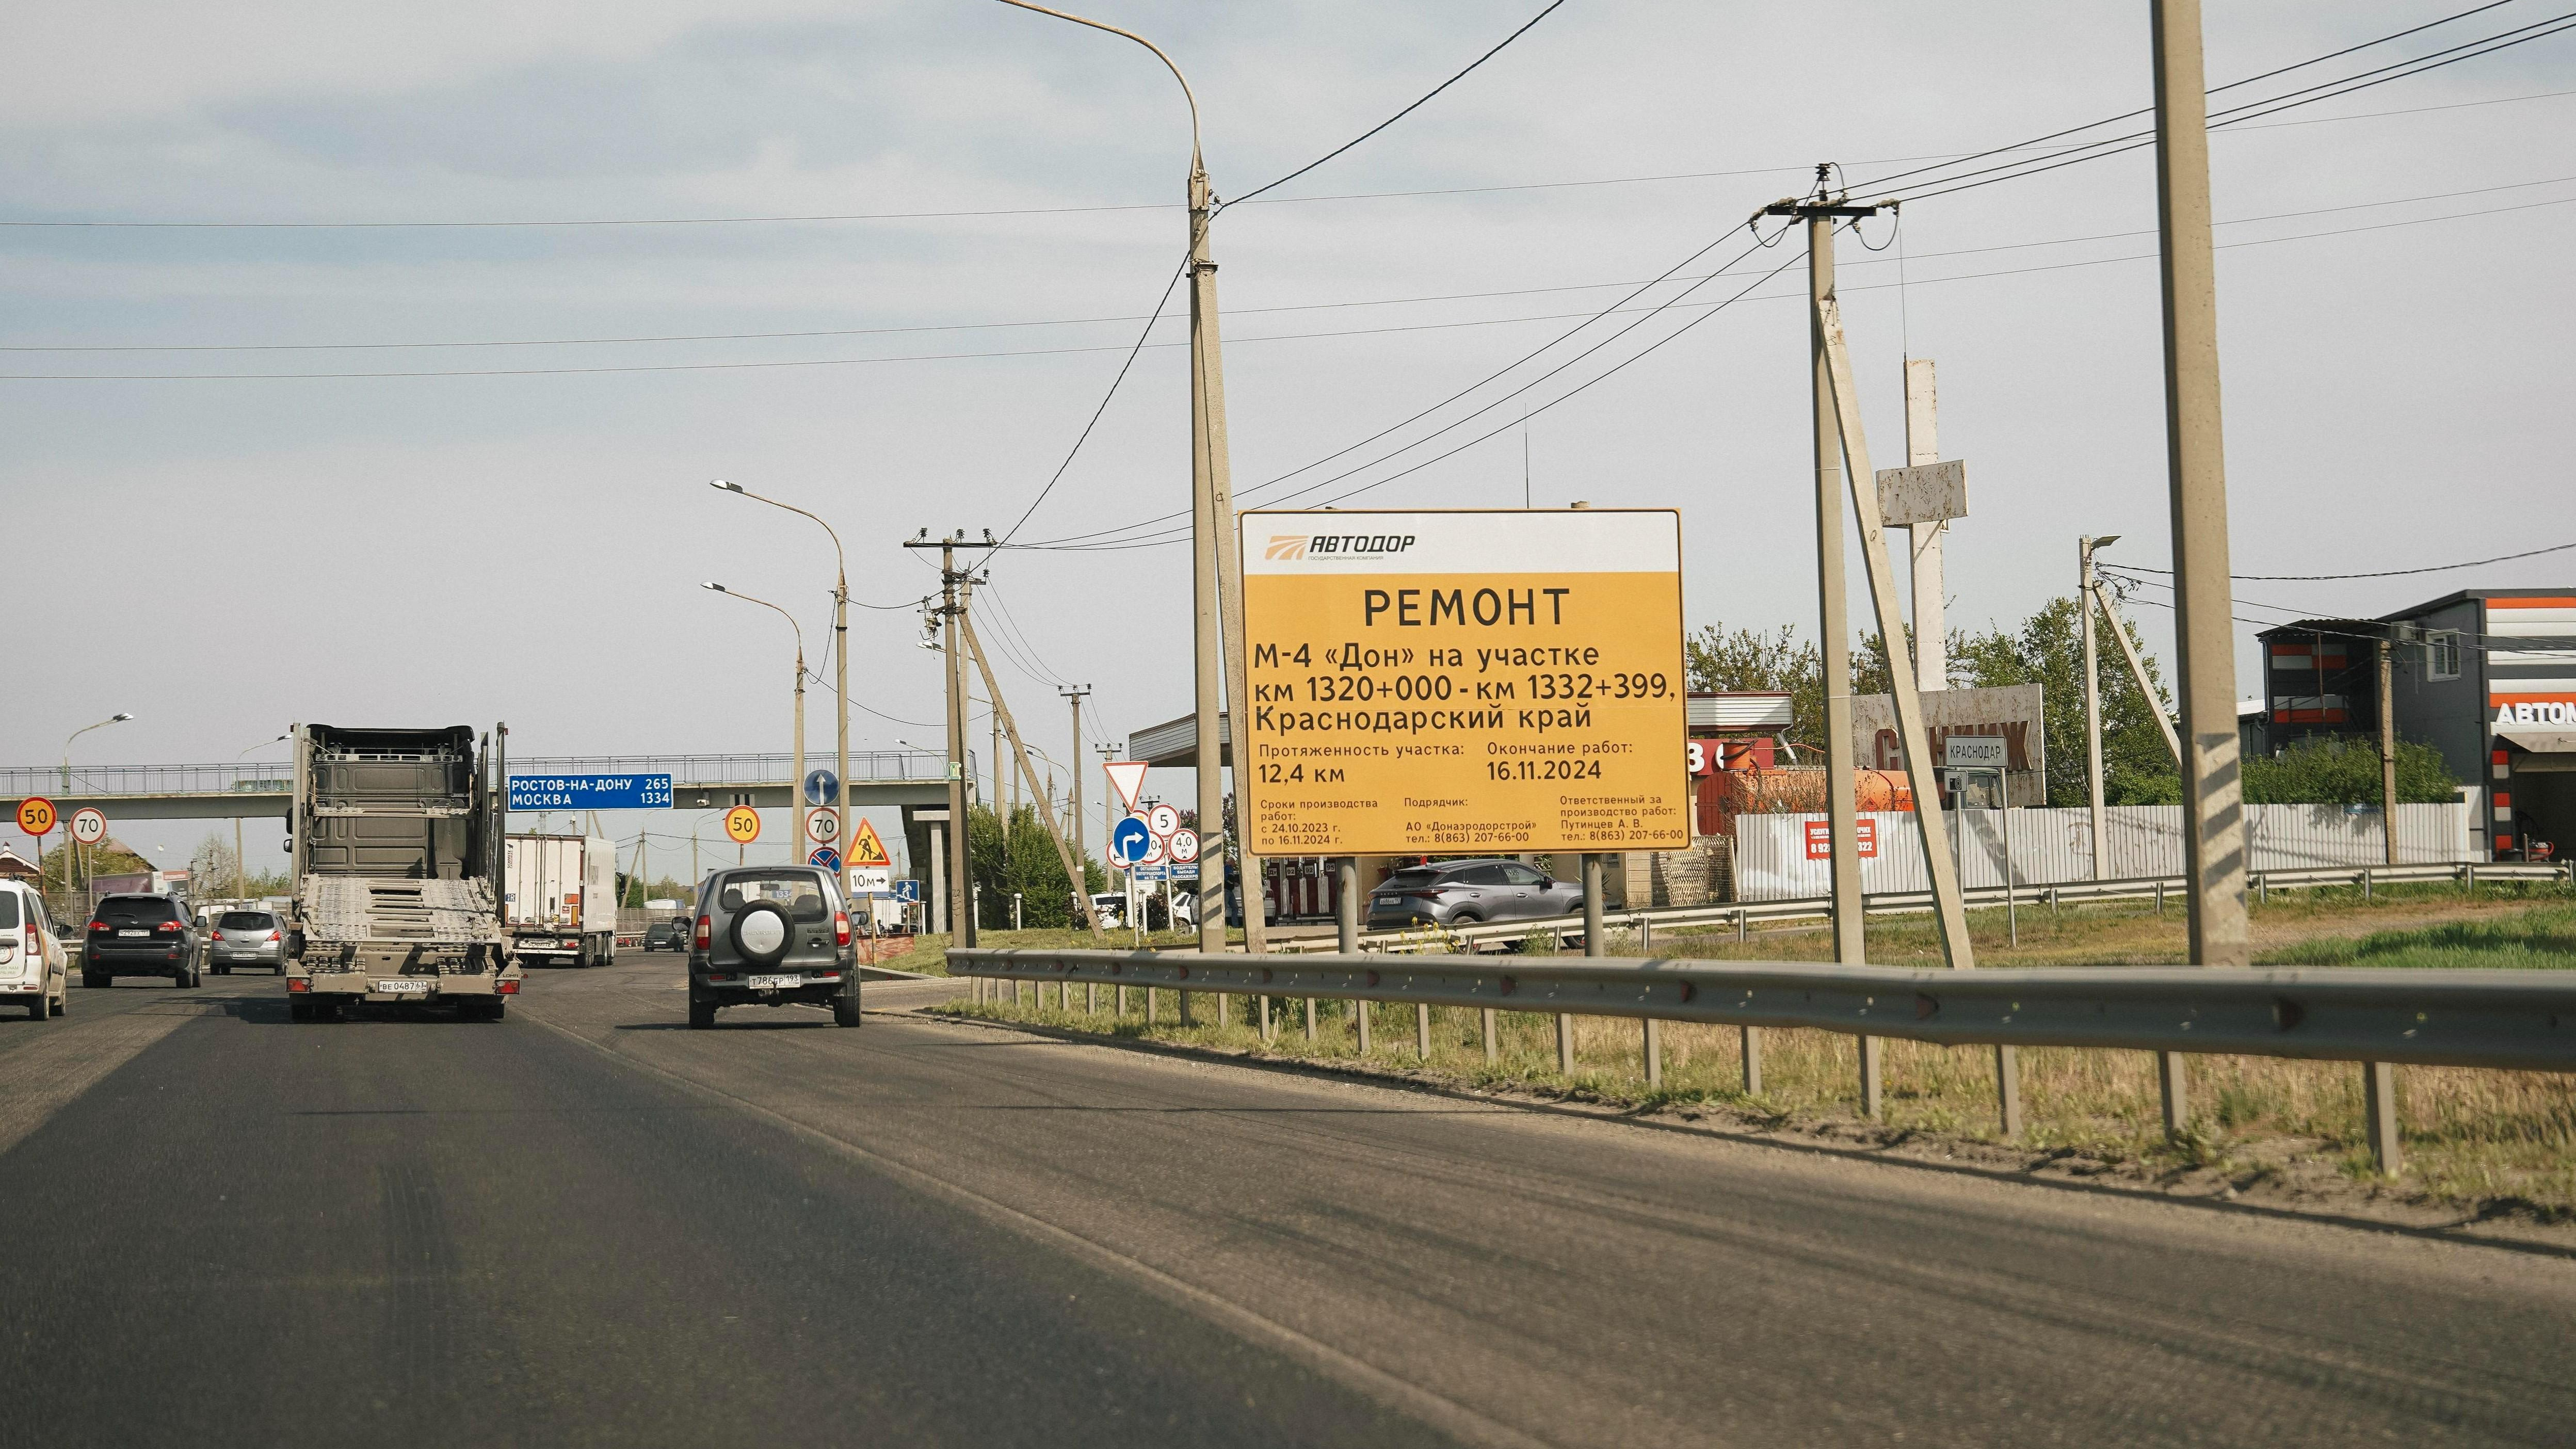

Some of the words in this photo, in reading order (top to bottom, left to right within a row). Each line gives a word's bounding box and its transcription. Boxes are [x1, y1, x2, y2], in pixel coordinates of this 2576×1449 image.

[1309, 536, 1415, 553] АВТОДОР
[1364, 588, 1570, 626] РЕМОНТ
[1254, 643, 1312, 668] М-4
[1325, 642, 1414, 671] «Дон»
[1429, 648, 1463, 667] на
[1477, 647, 1599, 673] участке
[1255, 684, 1294, 702] км
[1307, 674, 1452, 702] 1320+000
[1477, 681, 1515, 700] км
[1527, 673, 1675, 702] 1332+399,
[1256, 703, 1505, 735] Краснодарский
[1519, 702, 1590, 734] край
[1260, 744, 1389, 760] Протяженность
[1396, 745, 1464, 759] участка:
[1487, 742, 1575, 755] Окончание
[1583, 740, 1632, 756] работ:
[1950, 745, 2001, 761] КРАСНОДАР
[1259, 763, 1304, 786] 12,4
[1315, 768, 1345, 782] км
[1487, 760, 1602, 781] 16.11.2024
[511, 779, 633, 792] РОСТОВ-НА-ДОНУ
[645, 778, 669, 790] 265
[512, 794, 572, 805] МОСКВА
[640, 793, 670, 804] 1334
[1260, 799, 1295, 811] Сроки
[1300, 800, 1378, 810] производства
[1404, 797, 1468, 809] Подрядчик:
[1560, 795, 1645, 805] Ответственный
[25, 809, 47, 825] 50
[1261, 811, 1296, 822] работ:
[1560, 809, 1638, 818] производство
[1642, 806, 1676, 817] работ:
[79, 818, 99, 833] 70
[733, 817, 753, 833] 50
[814, 819, 834, 833] 70
[1160, 814, 1169, 828] 5
[1272, 823, 1328, 833] 24.10.2023
[1406, 822, 1422, 831] АО
[1426, 820, 1536, 832] «Донаэродорстрой»
[1561, 819, 1613, 831] Путинцев
[1618, 819, 1629, 828] А.
[1633, 818, 1643, 828] В.
[1279, 834, 1330, 845] 16.11.2024
[1435, 831, 1470, 844] 8(863)
[1474, 832, 1529, 842] 207-66-00
[1589, 829, 1624, 841] 8(863)
[1629, 830, 1683, 840] 207-66-00
[1811, 844, 1817, 854] 8
[507, 893, 516, 901] IR
